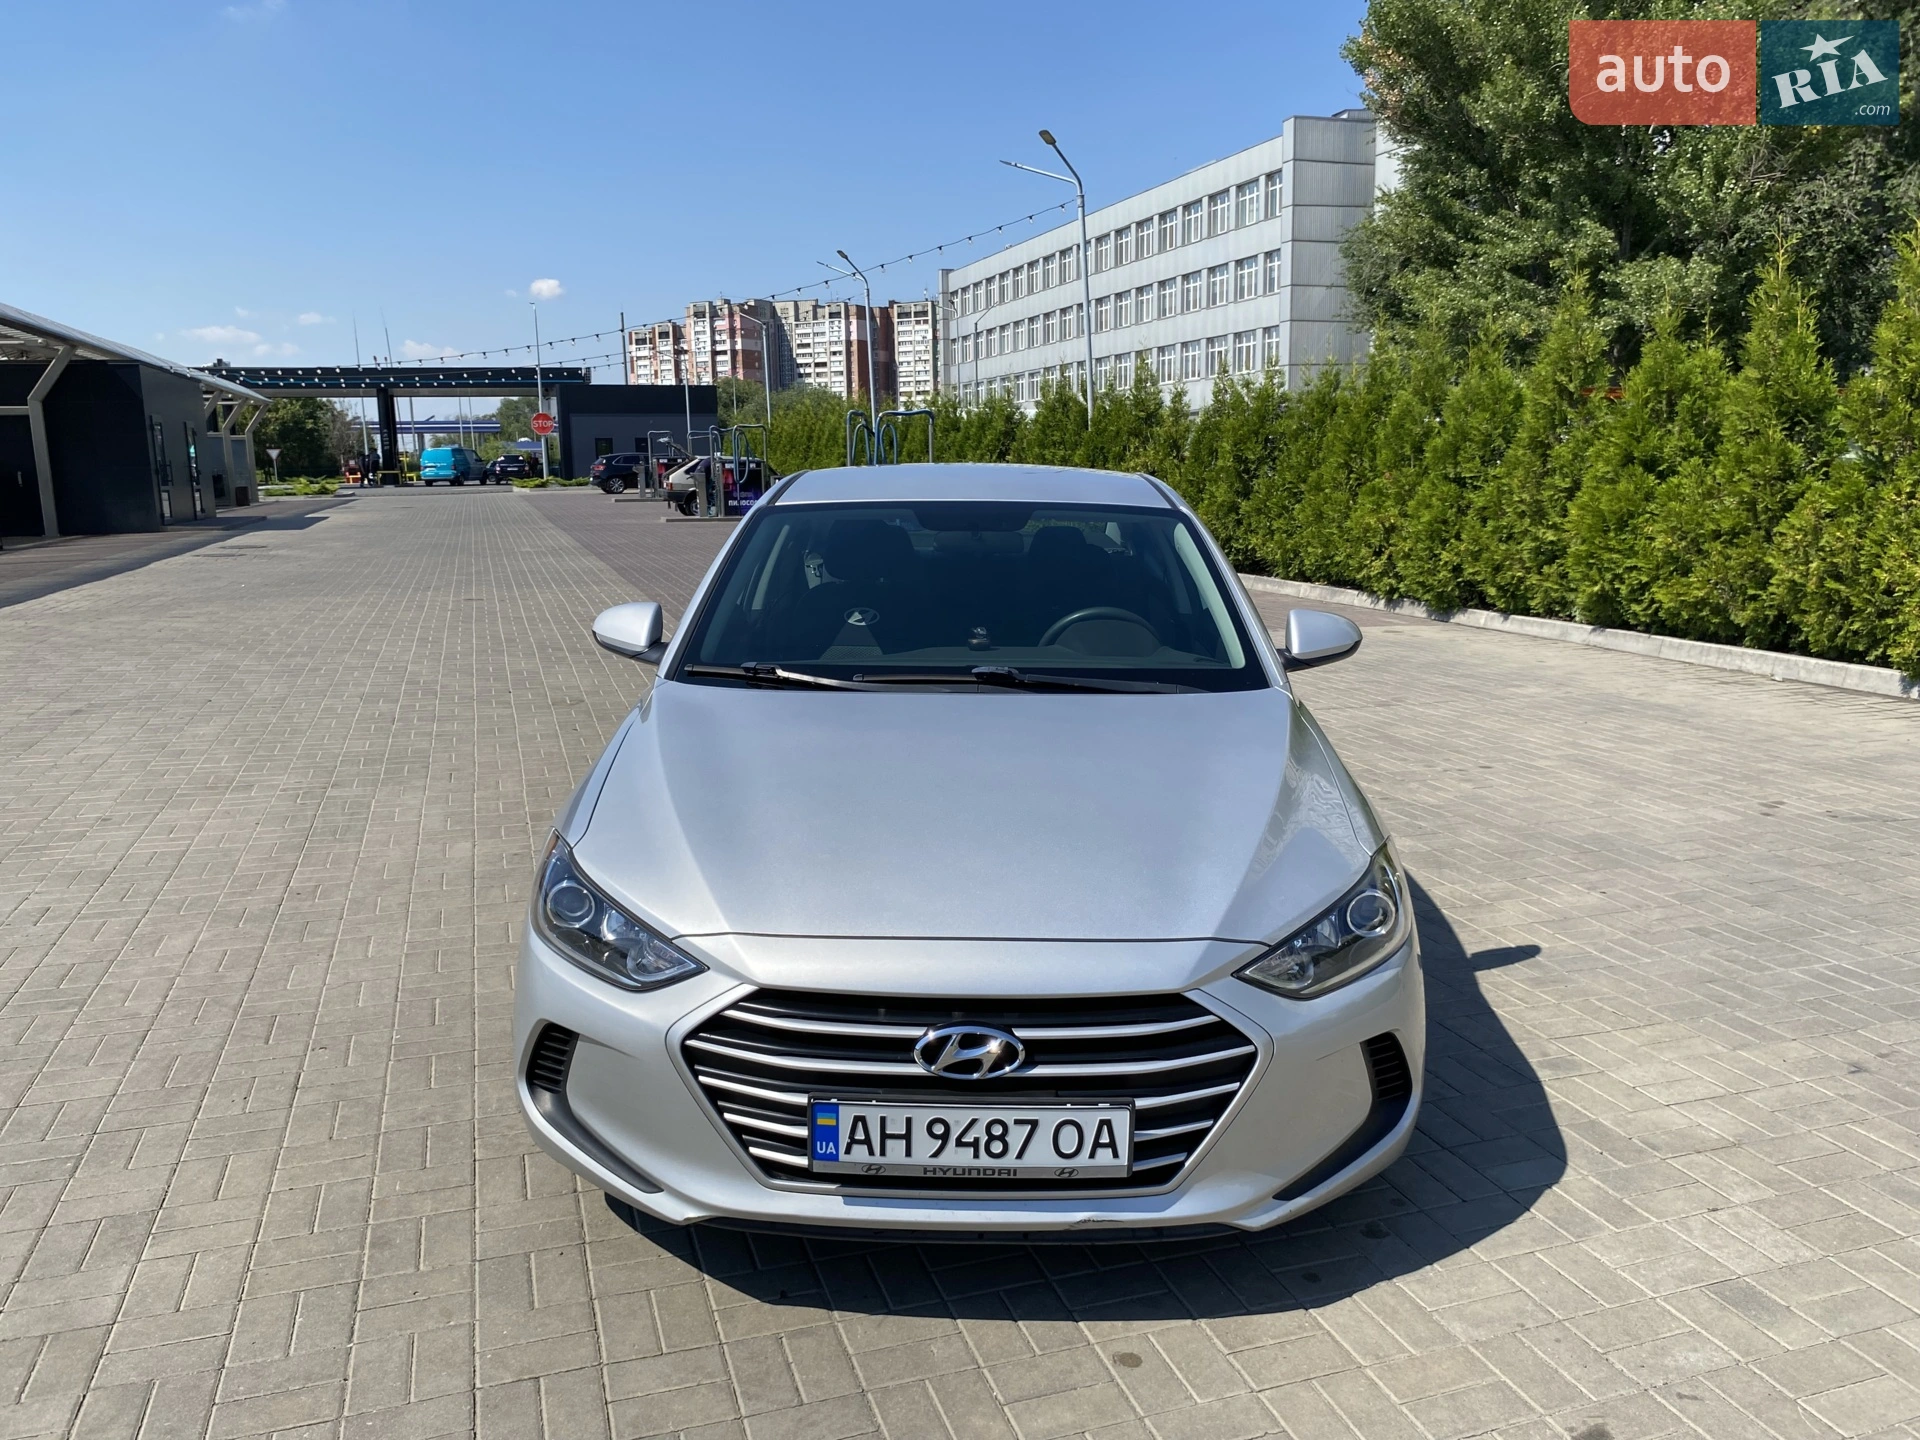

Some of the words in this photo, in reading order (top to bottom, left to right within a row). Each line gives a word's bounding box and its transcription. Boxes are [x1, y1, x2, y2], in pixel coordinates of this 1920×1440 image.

[533, 420, 553, 428] STOP
[843, 1114, 912, 1158] AH
[925, 1117, 1039, 1160] 9487
[1052, 1118, 1120, 1161] OA
[816, 1141, 837, 1156] UA
[922, 1166, 1018, 1178] HYUNDAI
